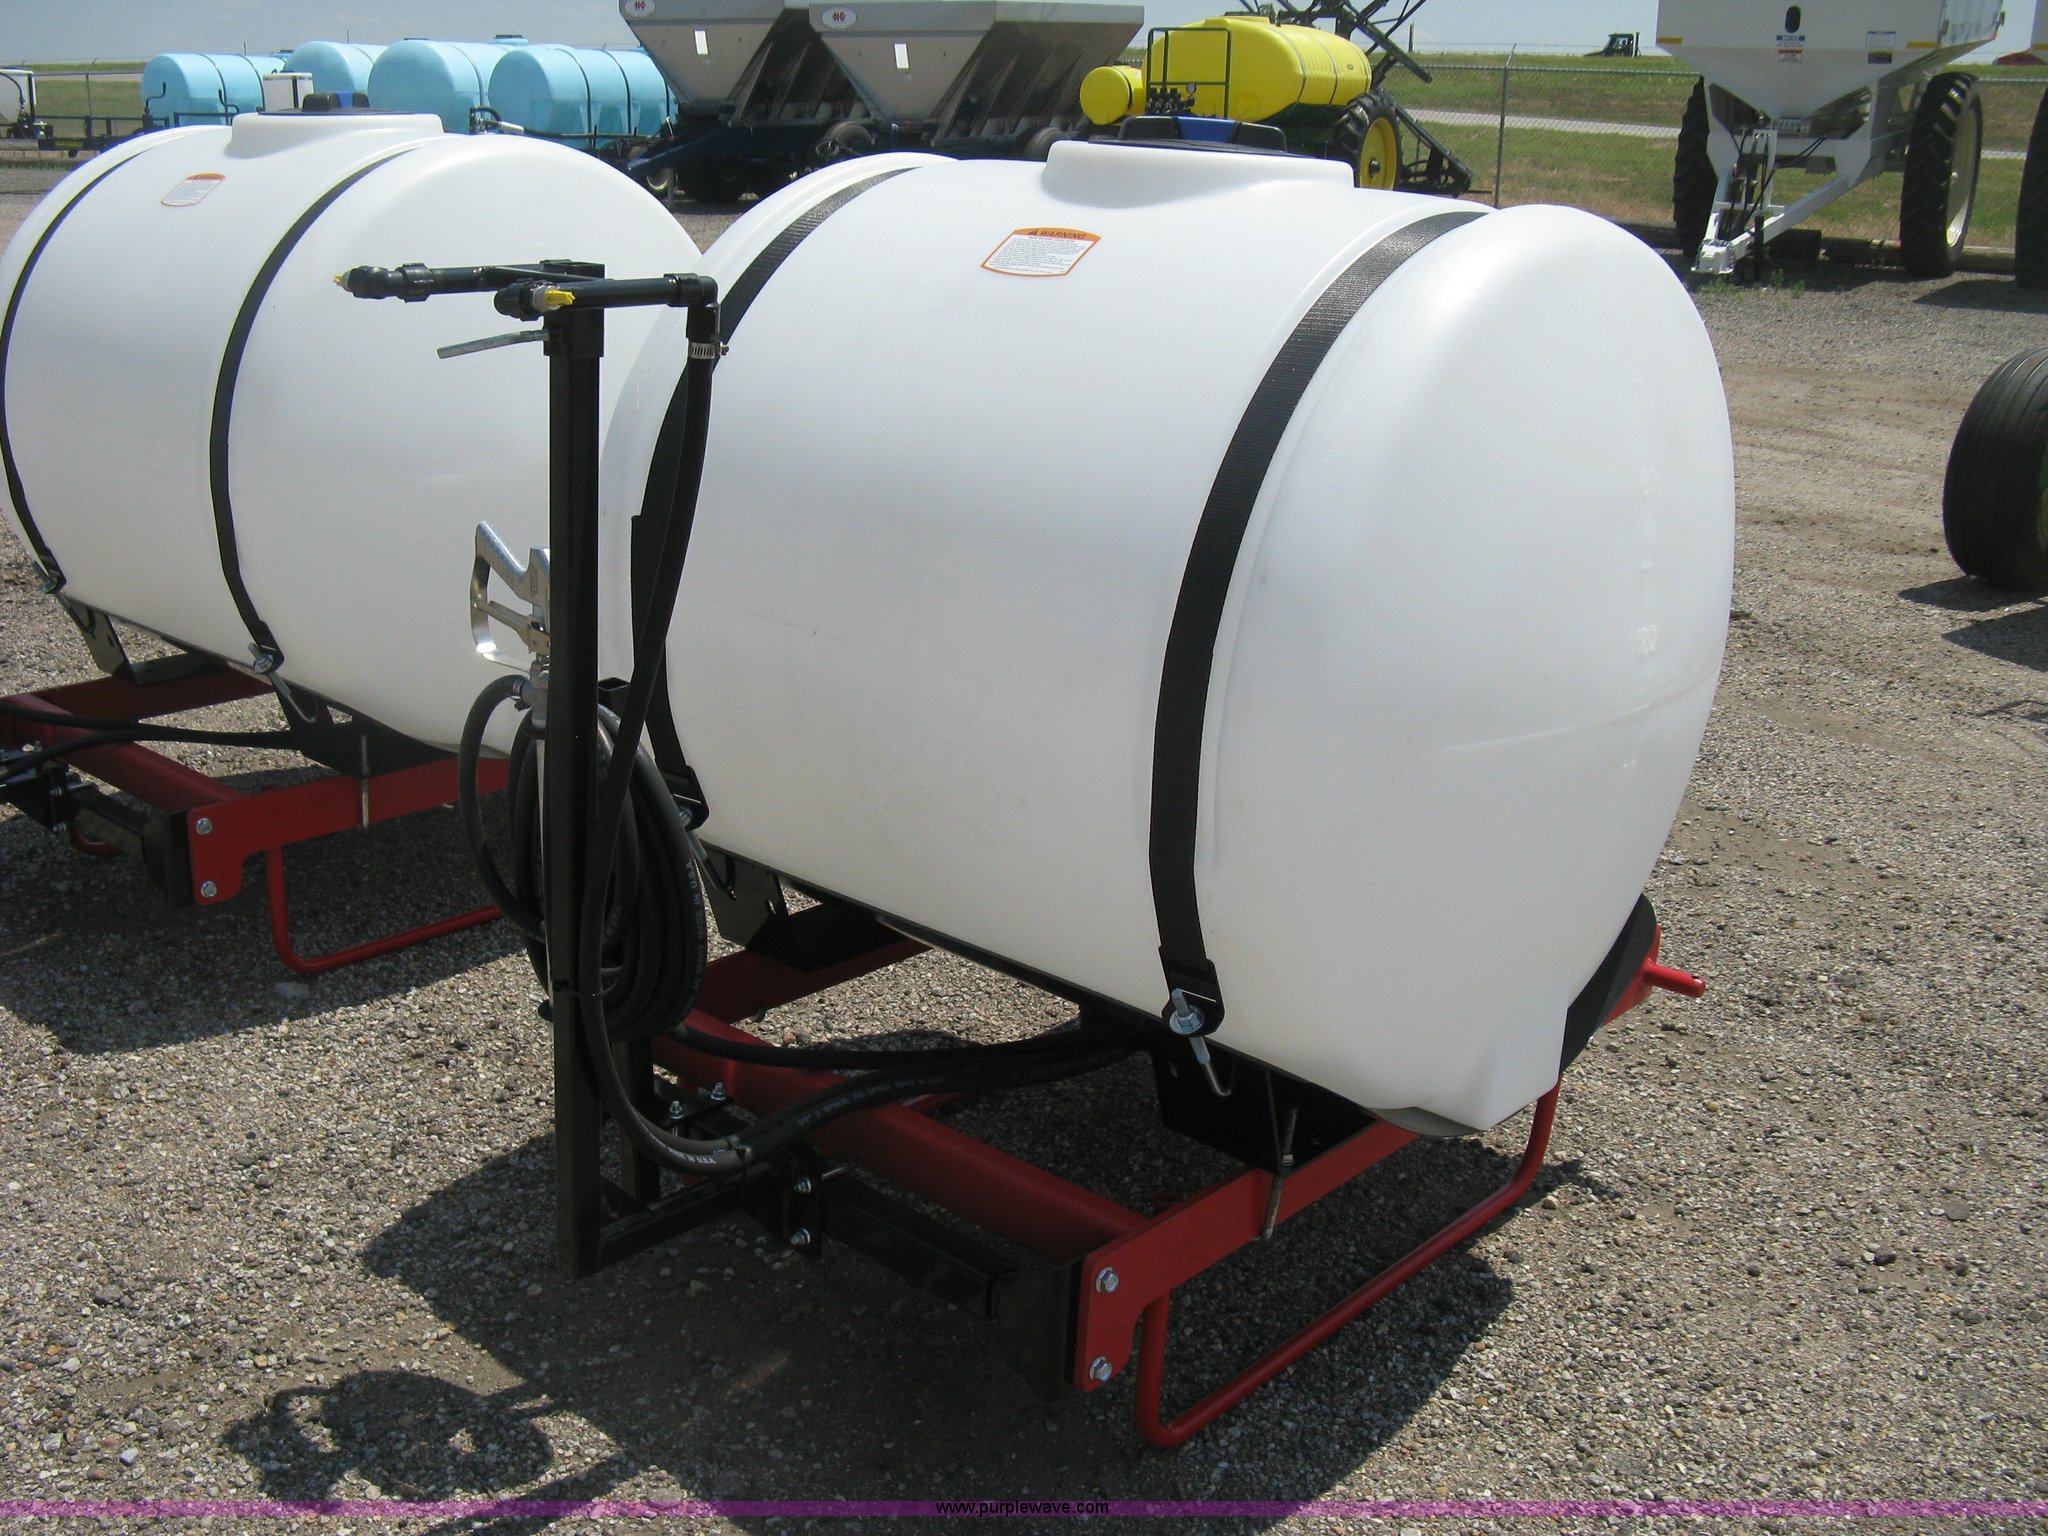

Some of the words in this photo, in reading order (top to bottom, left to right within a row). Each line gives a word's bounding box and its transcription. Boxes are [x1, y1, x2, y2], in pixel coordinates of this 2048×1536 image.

[1040, 230, 1086, 240] WARNING
[693, 894, 701, 905] IN
[695, 910, 704, 939] MADE
